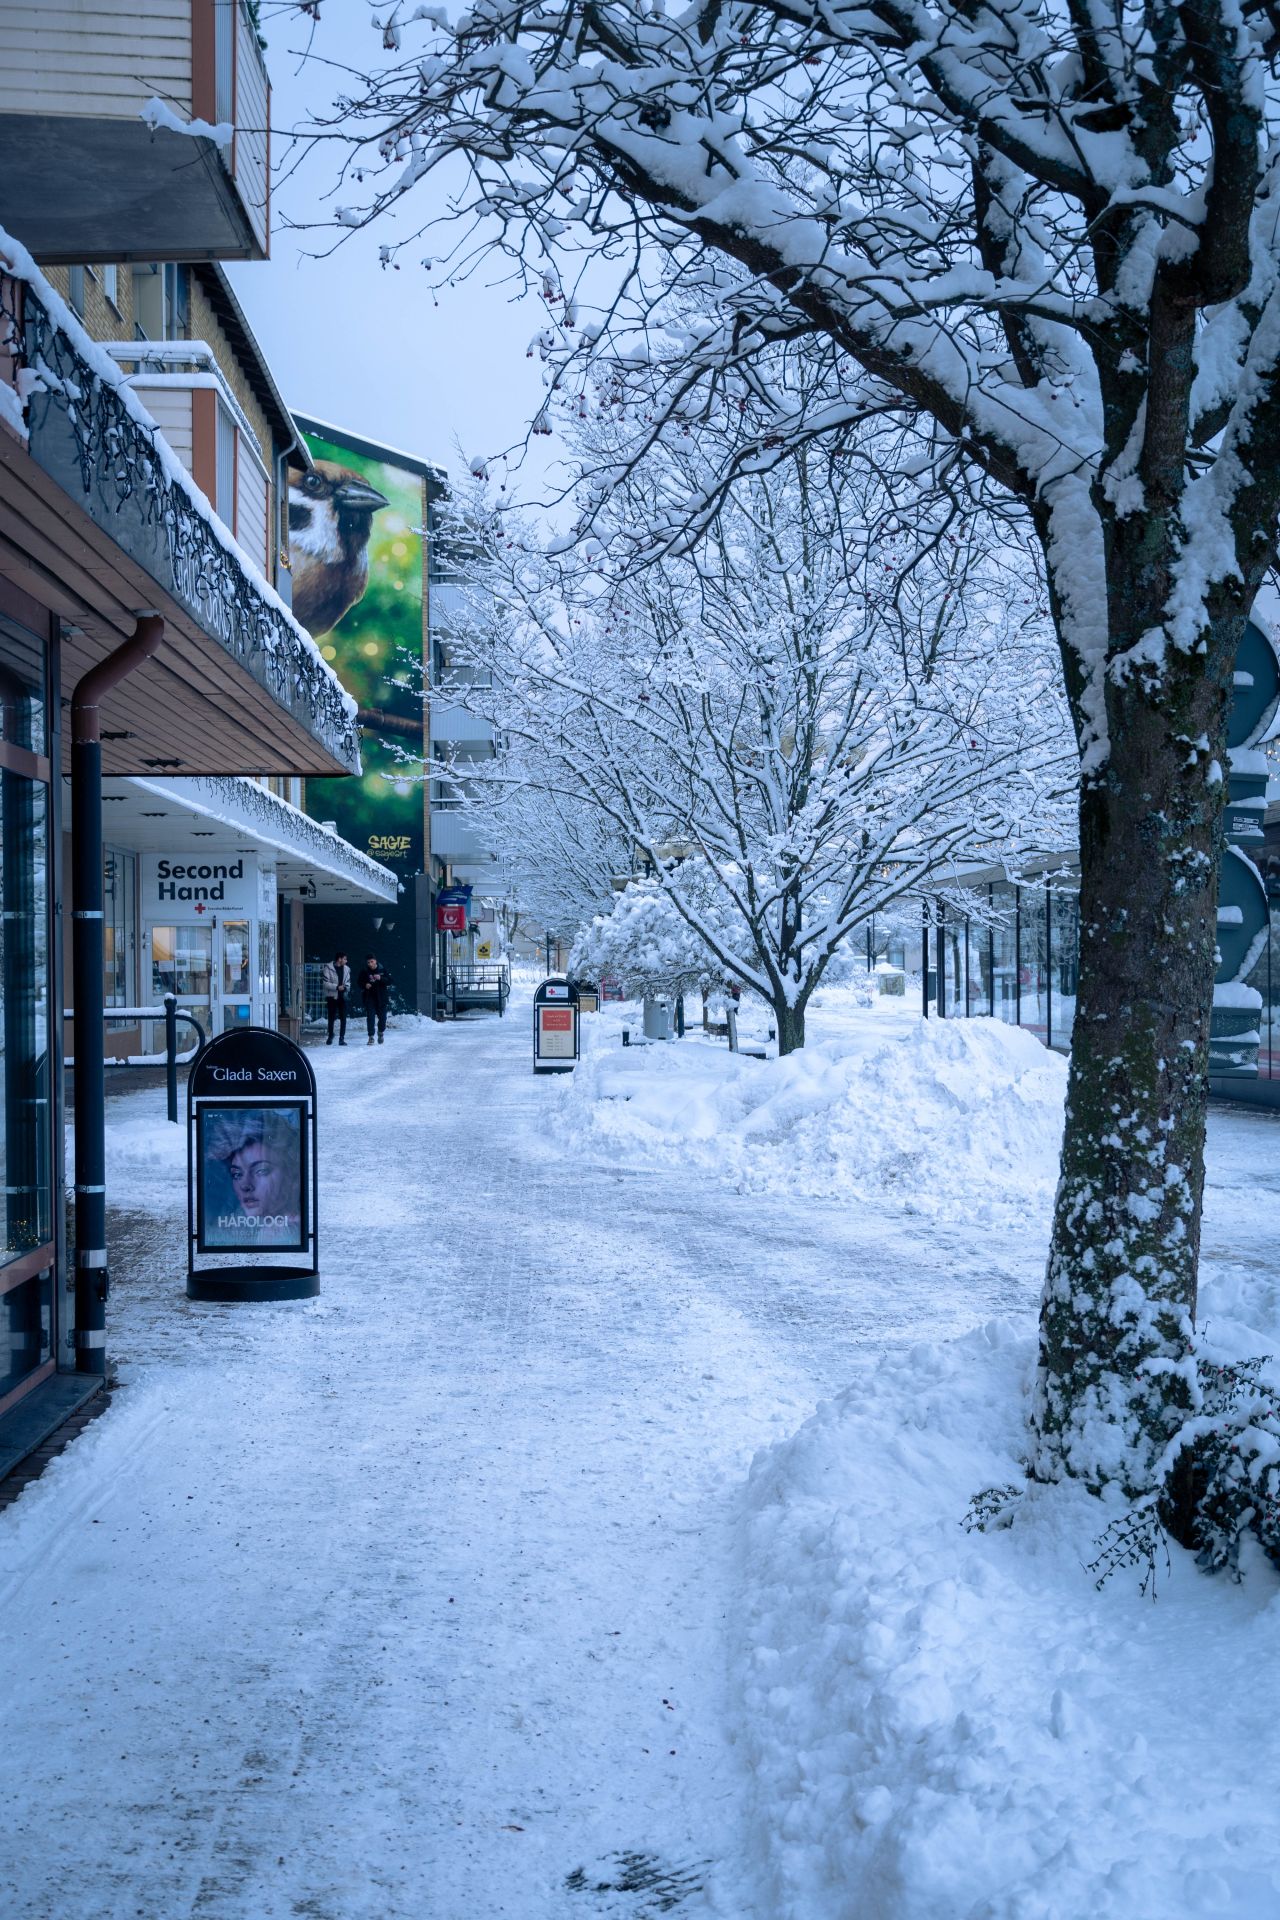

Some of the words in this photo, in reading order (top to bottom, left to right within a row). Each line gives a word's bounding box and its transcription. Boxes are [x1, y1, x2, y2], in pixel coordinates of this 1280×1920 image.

[157, 859, 243, 880] Second
[158, 881, 225, 900] Hand
[213, 1067, 252, 1081] Glada
[257, 1067, 297, 1081] Saxen
[218, 1212, 289, 1228] HÅROLOGI
